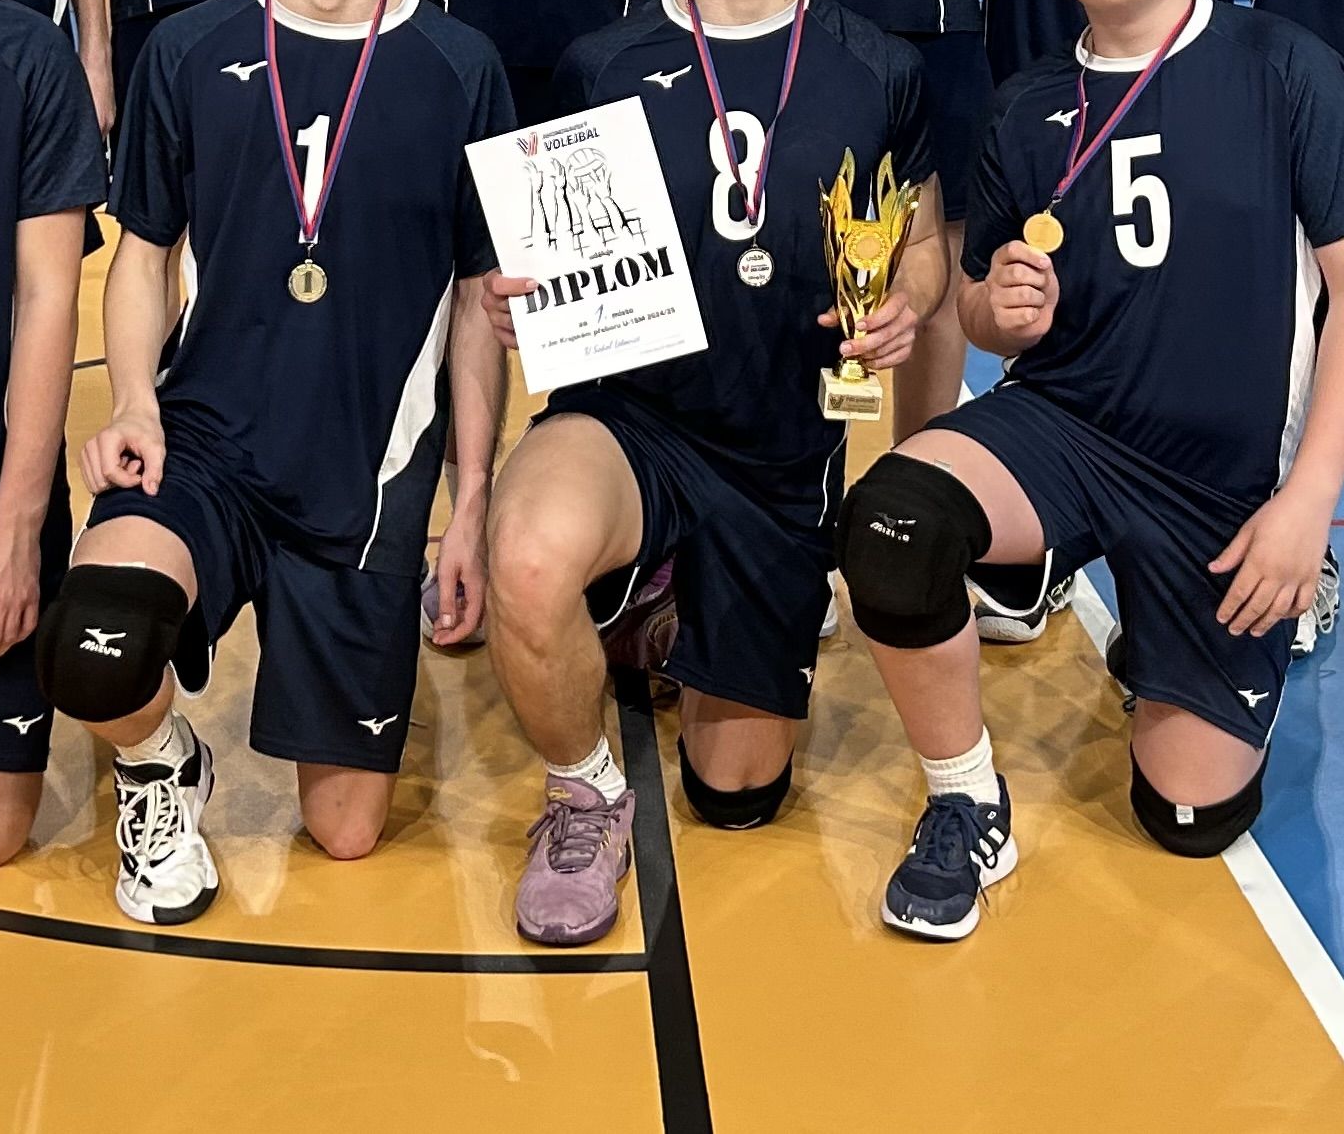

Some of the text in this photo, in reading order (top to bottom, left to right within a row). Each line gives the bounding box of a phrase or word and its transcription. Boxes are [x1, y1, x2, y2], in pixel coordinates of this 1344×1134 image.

[296, 114, 330, 244] 1
[544, 127, 600, 151] VOLEJBAL
[709, 110, 766, 241] 8
[1111, 133, 1171, 268] 5
[525, 246, 674, 314] DIPLOM
[869, 521, 910, 543] MIZUO
